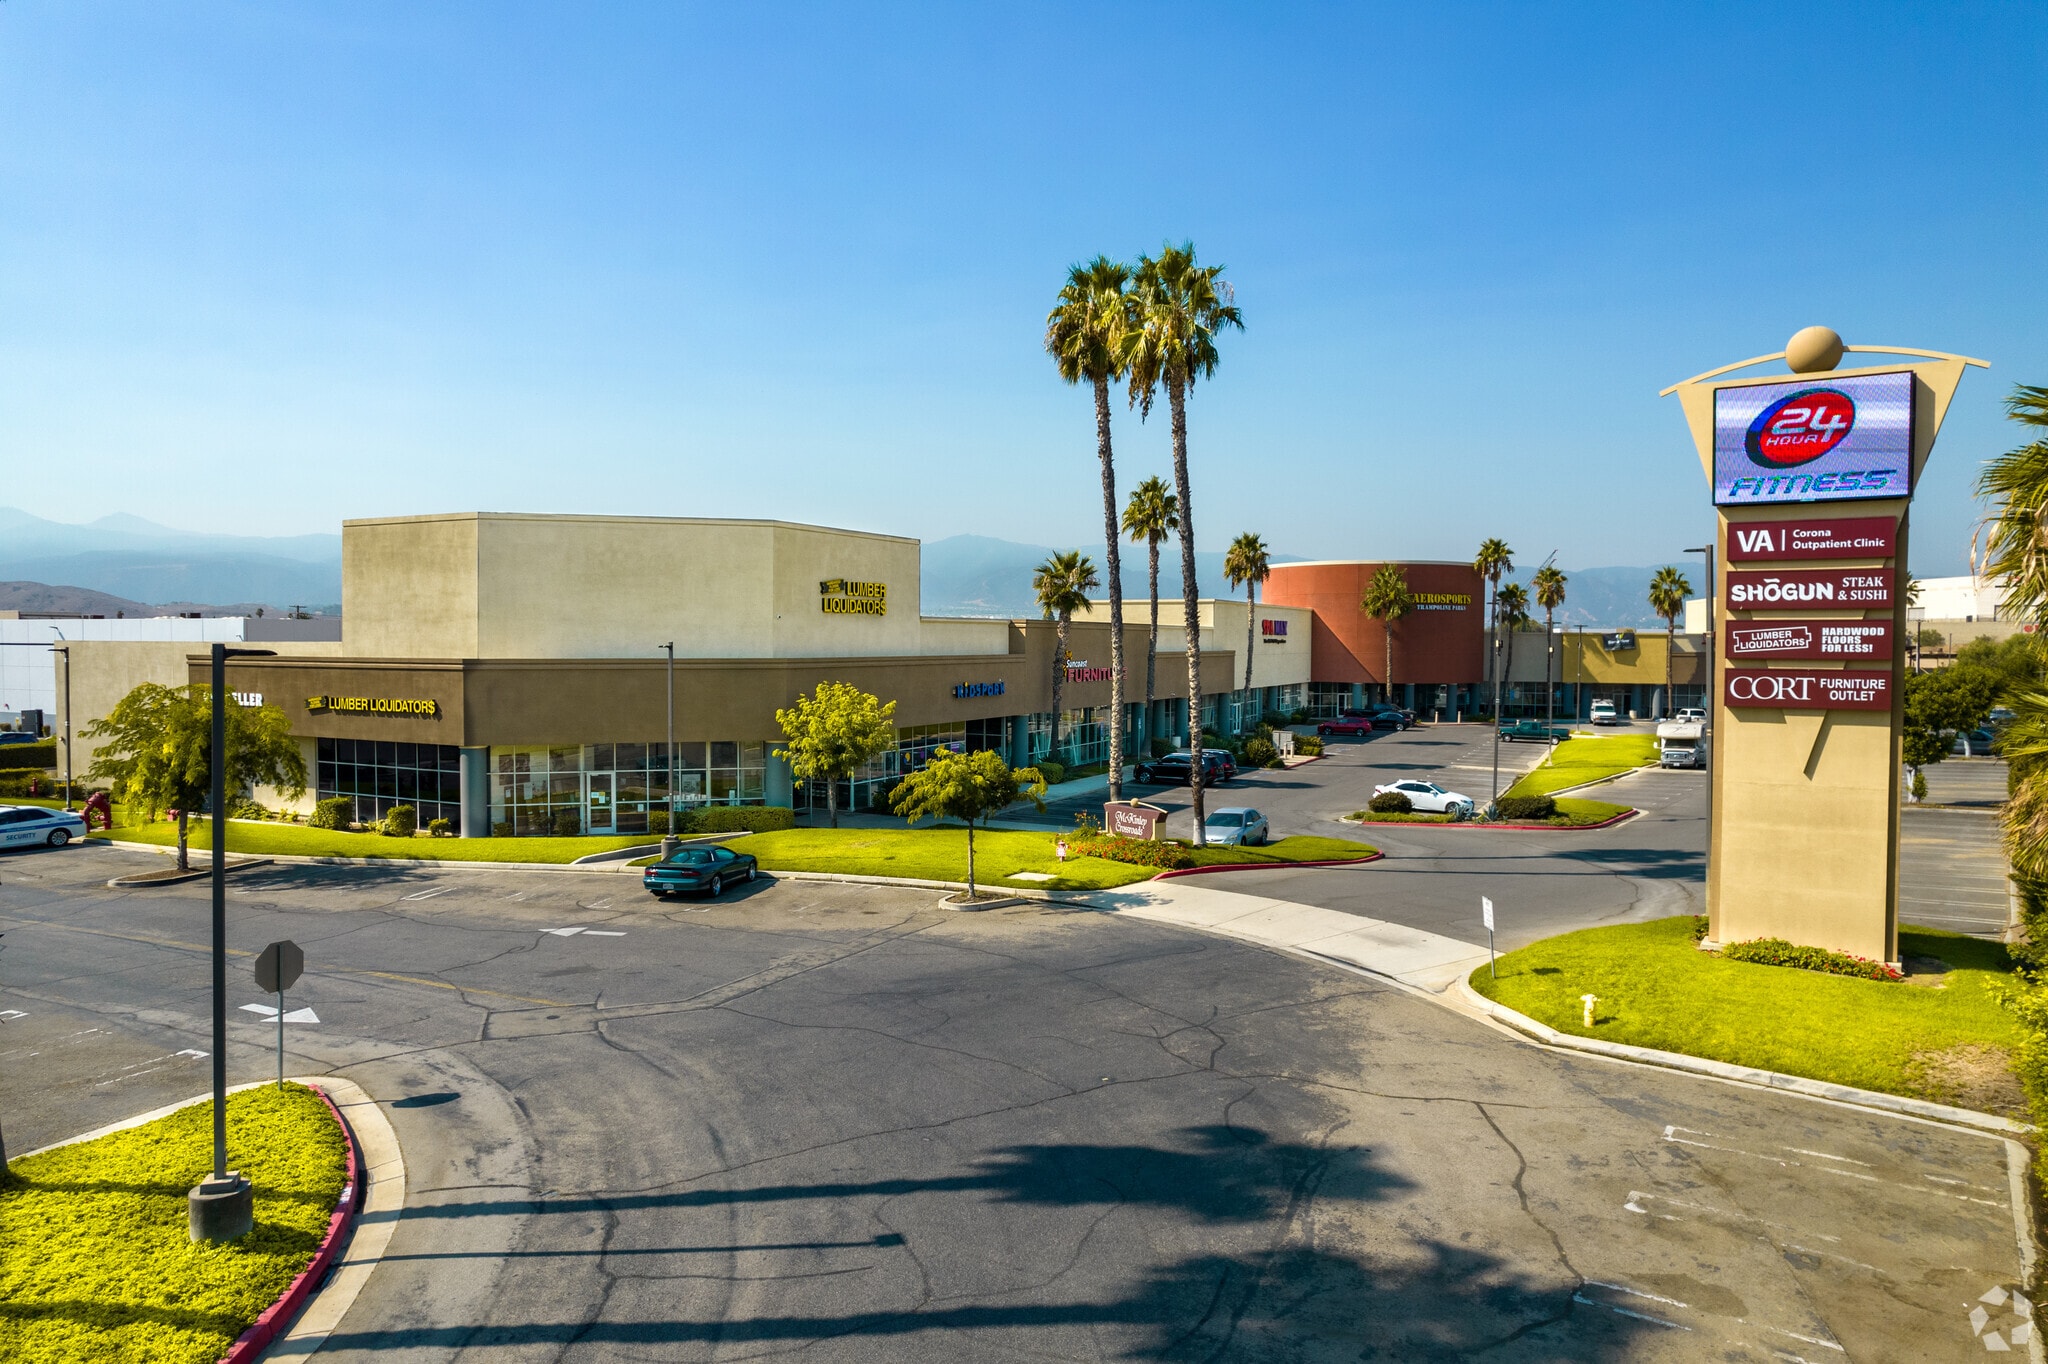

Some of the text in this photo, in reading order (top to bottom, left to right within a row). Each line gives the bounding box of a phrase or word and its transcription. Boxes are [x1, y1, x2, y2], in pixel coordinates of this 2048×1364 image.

[1771, 405, 1848, 443] 24
[1765, 433, 1818, 447] HOUR
[1792, 529, 1832, 538] Corona
[1736, 529, 1775, 553] VA
[1792, 538, 1885, 551] Outpatient Clinic
[1842, 576, 1884, 587] STEAK
[846, 581, 887, 597] LUMBER
[1837, 589, 1888, 600] & SUSHI
[1412, 593, 1472, 604] AEROSPORTS
[1751, 630, 1793, 641] LUMBER
[1821, 627, 1885, 636] HARDWOOD
[1740, 638, 1806, 650] LIQUIDATORS
[1821, 636, 1862, 644] FLOORS
[1821, 644, 1873, 653] FOR LESS!
[1067, 666, 1128, 683] FURNITUE
[1729, 676, 1816, 700] CORT
[1820, 678, 1886, 689] FURNITURE
[1829, 690, 1876, 701] OUTLET
[328, 697, 368, 711] LUMBER
[1115, 811, 1147, 829] McKinley
[1115, 822, 1143, 836] Crossroads
[7, 833, 36, 841] SECURITY
